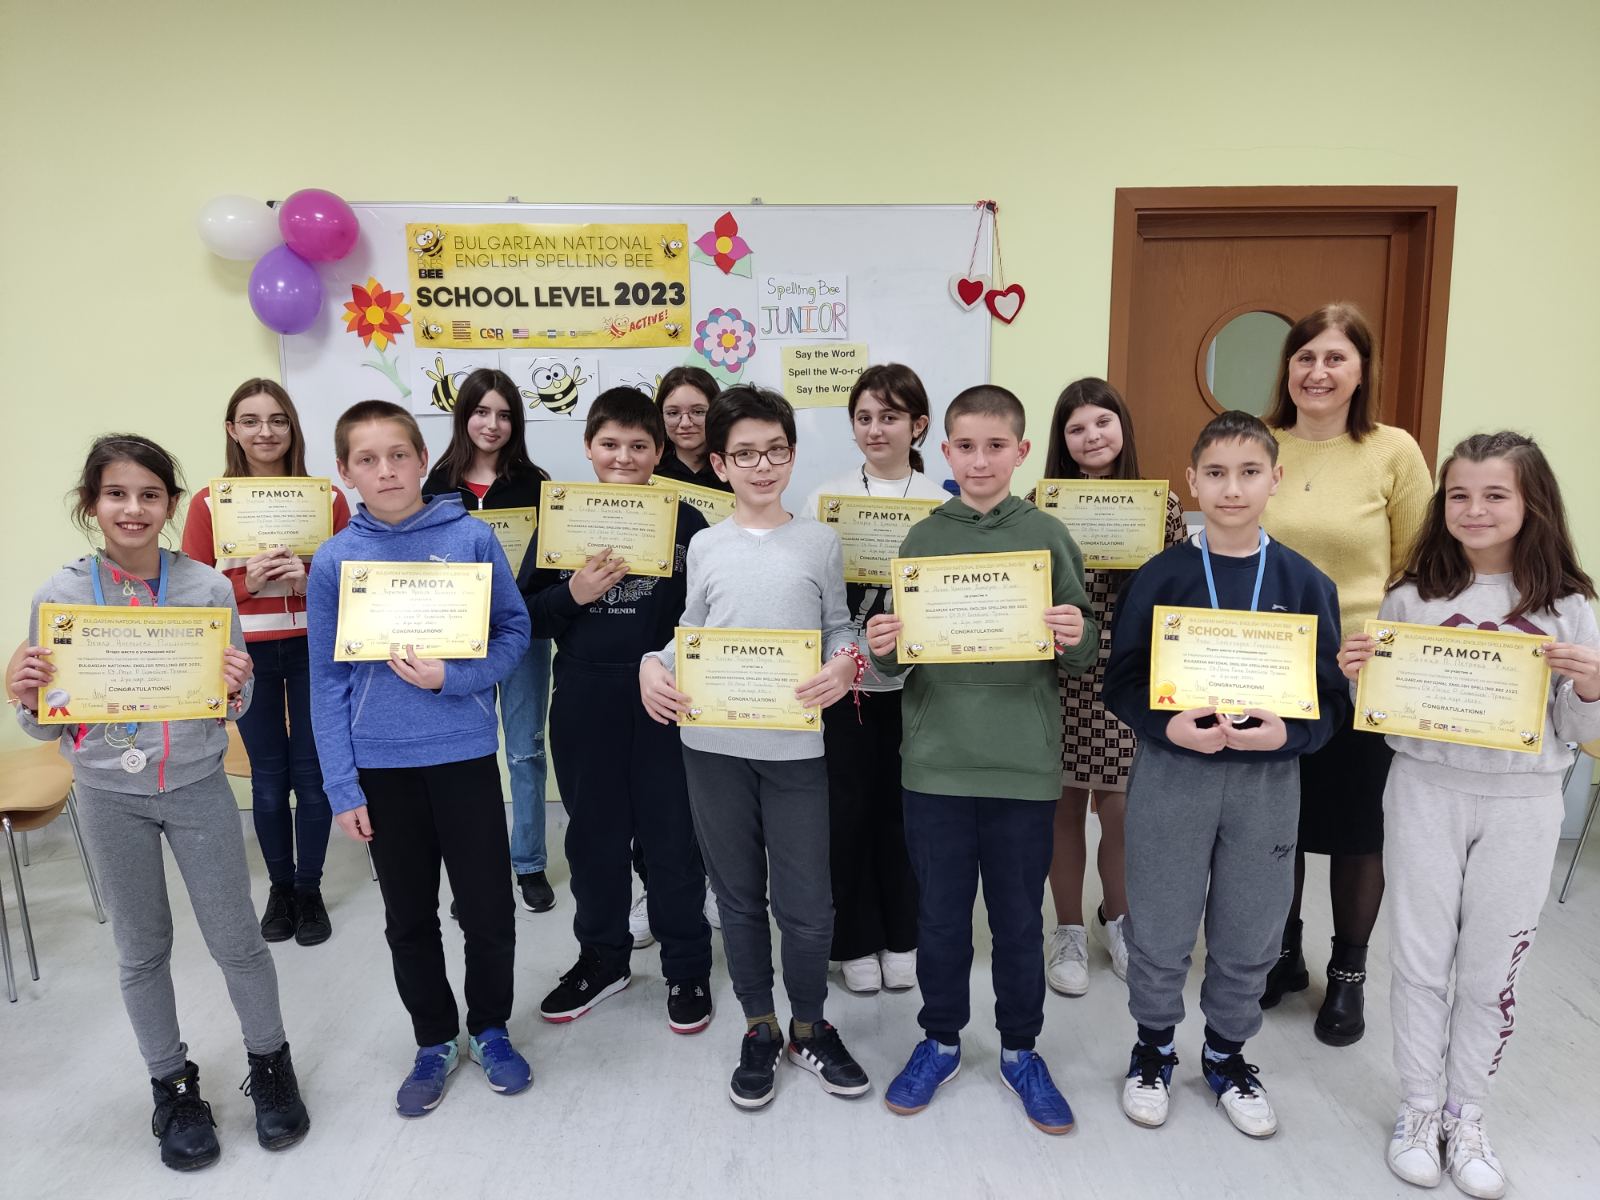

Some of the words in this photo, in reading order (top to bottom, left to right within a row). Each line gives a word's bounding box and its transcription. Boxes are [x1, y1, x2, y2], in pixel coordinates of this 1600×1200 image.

[454, 236, 556, 250] BULGARIAN
[563, 236, 652, 250] NATIONAL
[455, 254, 529, 268] ENGLISH
[535, 254, 617, 268] SPELLING
[624, 254, 654, 268] BEE
[418, 269, 444, 279] BEE
[416, 286, 529, 307] SCHOOL
[535, 286, 609, 307] LEVEL
[614, 282, 686, 306] 2023
[767, 277, 817, 304] Spelling
[819, 279, 841, 296] Bee
[629, 309, 669, 332] ACTIVE!
[761, 302, 847, 335] JUNIOR
[795, 351, 812, 360] Say
[814, 350, 828, 358] the
[831, 349, 856, 358] Word
[788, 368, 811, 377] Spell
[813, 367, 828, 376] the
[830, 367, 863, 375] W-o-r-d
[796, 386, 813, 395] Say
[815, 385, 830, 393] the
[251, 490, 304, 498] ГРАМОТА
[1079, 495, 1134, 504] ГРАМОТА
[586, 498, 644, 509] ГРАМОТА
[858, 511, 911, 521] ГРАМОТА
[943, 571, 1010, 584] ГРАМОТА
[391, 578, 454, 589] ГРАМОТА
[81, 627, 141, 638] SCHOOL
[146, 627, 204, 638] WINNER
[1187, 625, 1238, 638] SCHOOL
[1242, 629, 1294, 642] WINNER
[723, 645, 784, 656] ГРАМОТА
[1422, 644, 1502, 662] ГРАМОТА
[176, 1083, 186, 1093] 3
